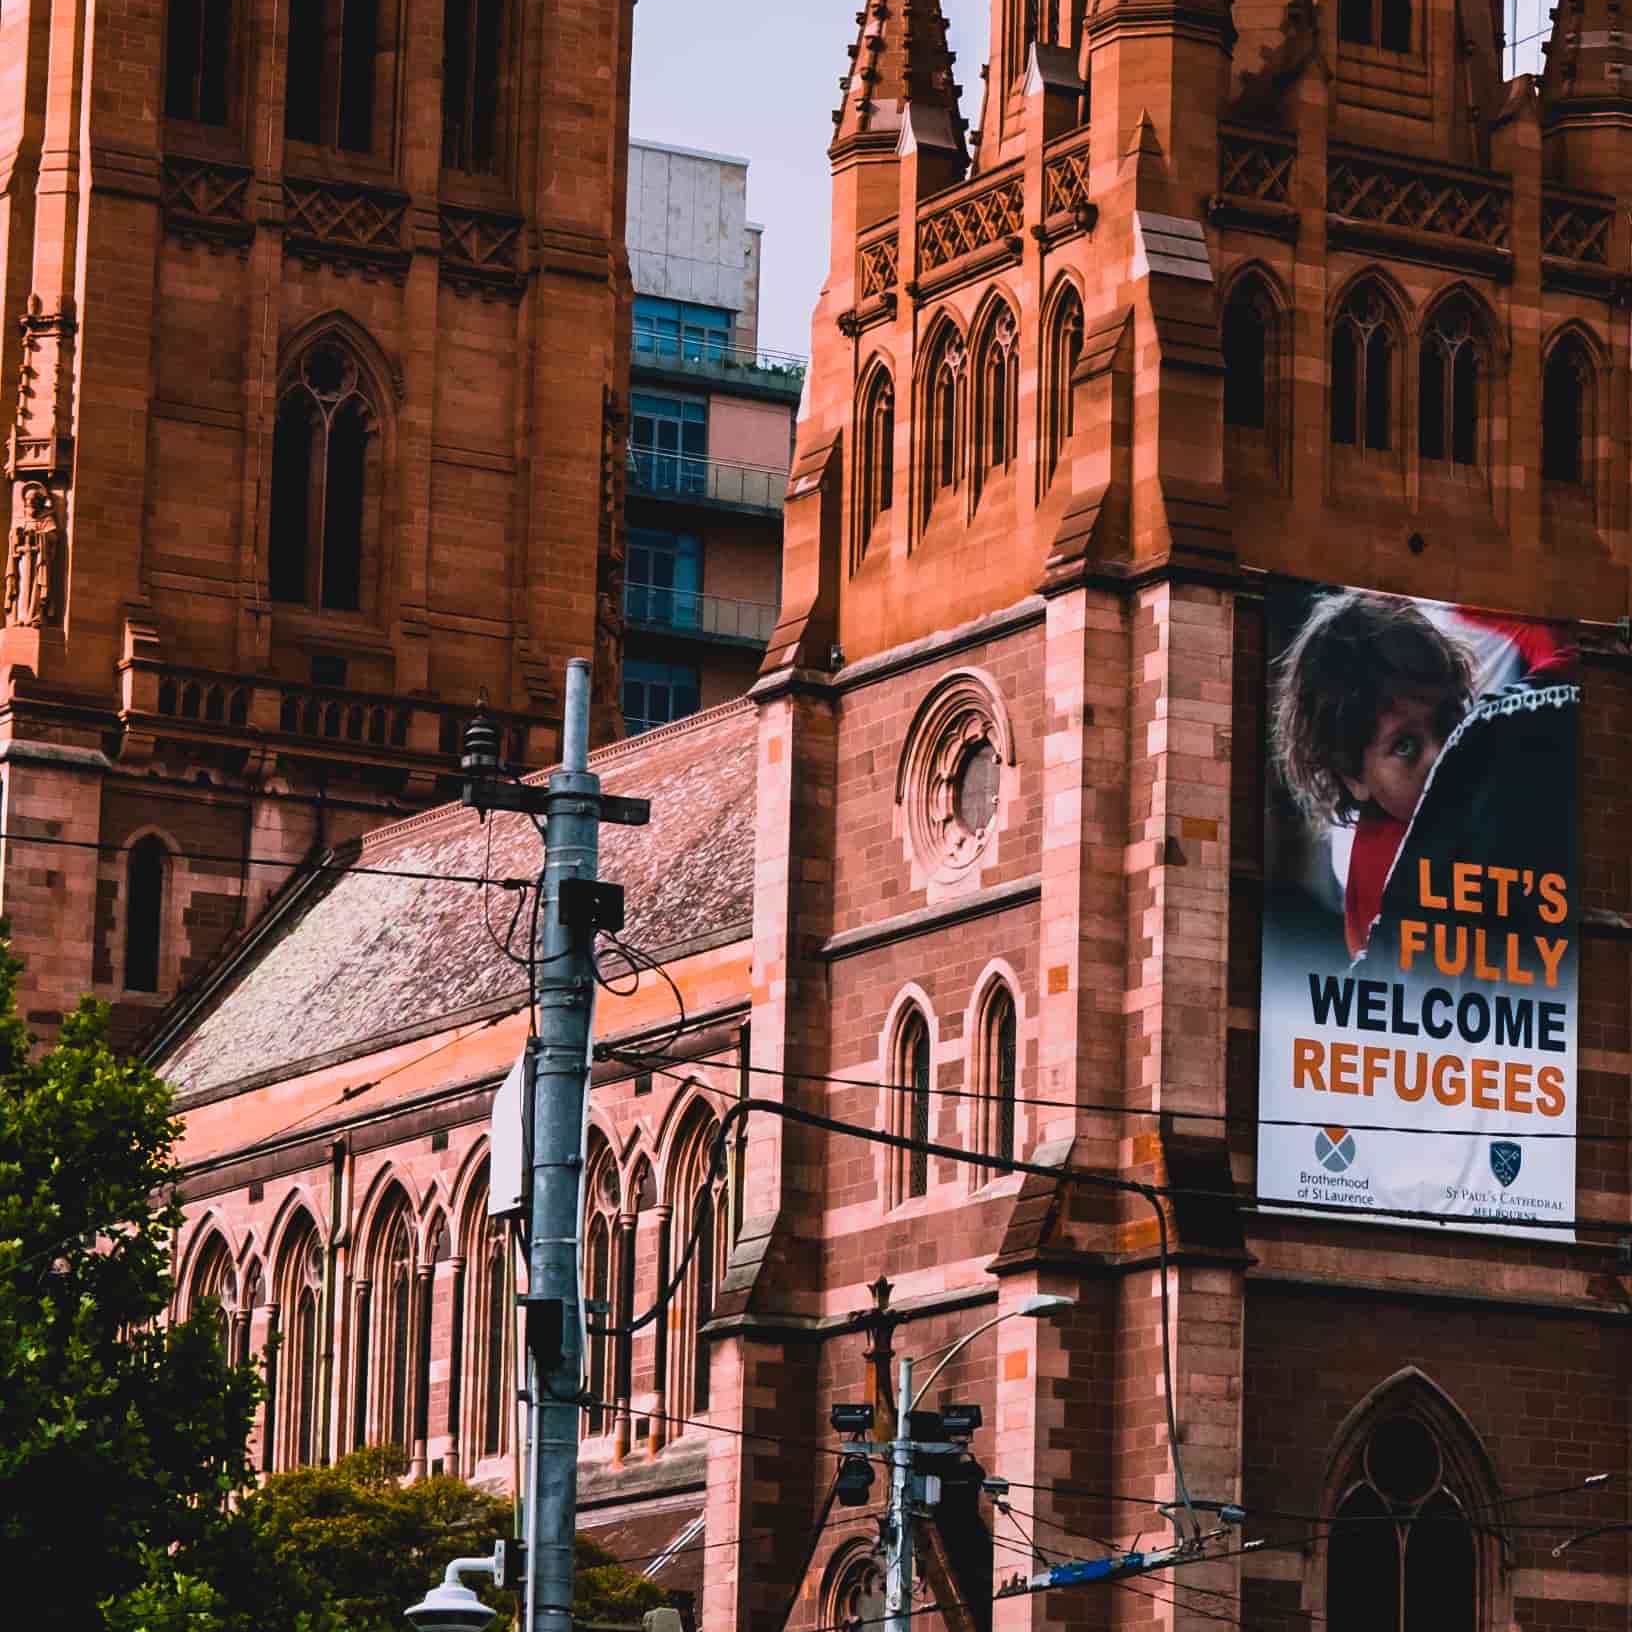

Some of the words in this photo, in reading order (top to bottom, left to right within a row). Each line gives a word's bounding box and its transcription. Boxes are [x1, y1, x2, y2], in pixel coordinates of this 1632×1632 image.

[1418, 858, 1568, 924] LET'S
[1399, 919, 1569, 988] FULLY
[1308, 973, 1567, 1053] WELCOME
[1292, 1037, 1566, 1118] REFUGEES
[1298, 1188, 1309, 1199] of
[1325, 1191, 1374, 1205] Laurence
[1300, 1171, 1369, 1190] Brotherhood
